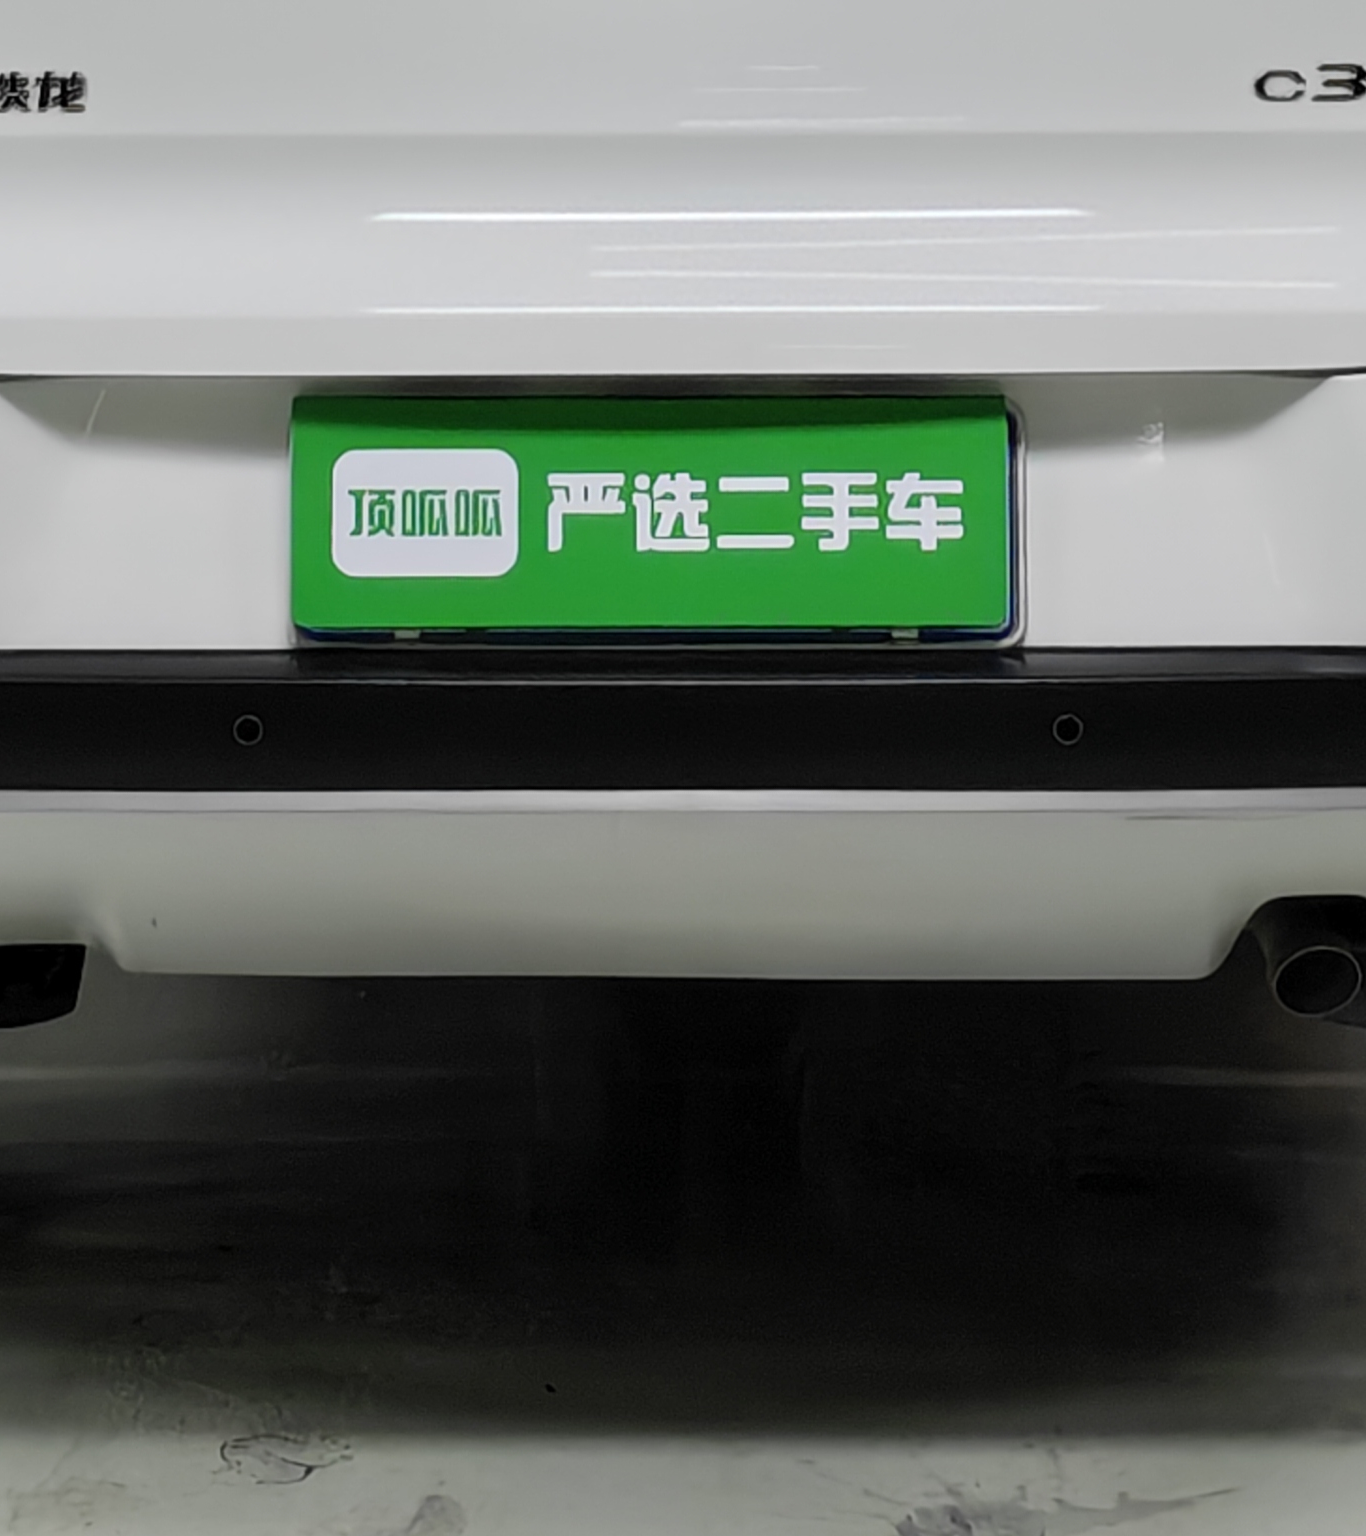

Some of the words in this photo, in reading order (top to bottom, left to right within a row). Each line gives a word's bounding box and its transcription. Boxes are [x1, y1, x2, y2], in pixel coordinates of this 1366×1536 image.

[348, 488, 503, 538] 顶呱呱
[546, 472, 965, 553] 严选二手车
